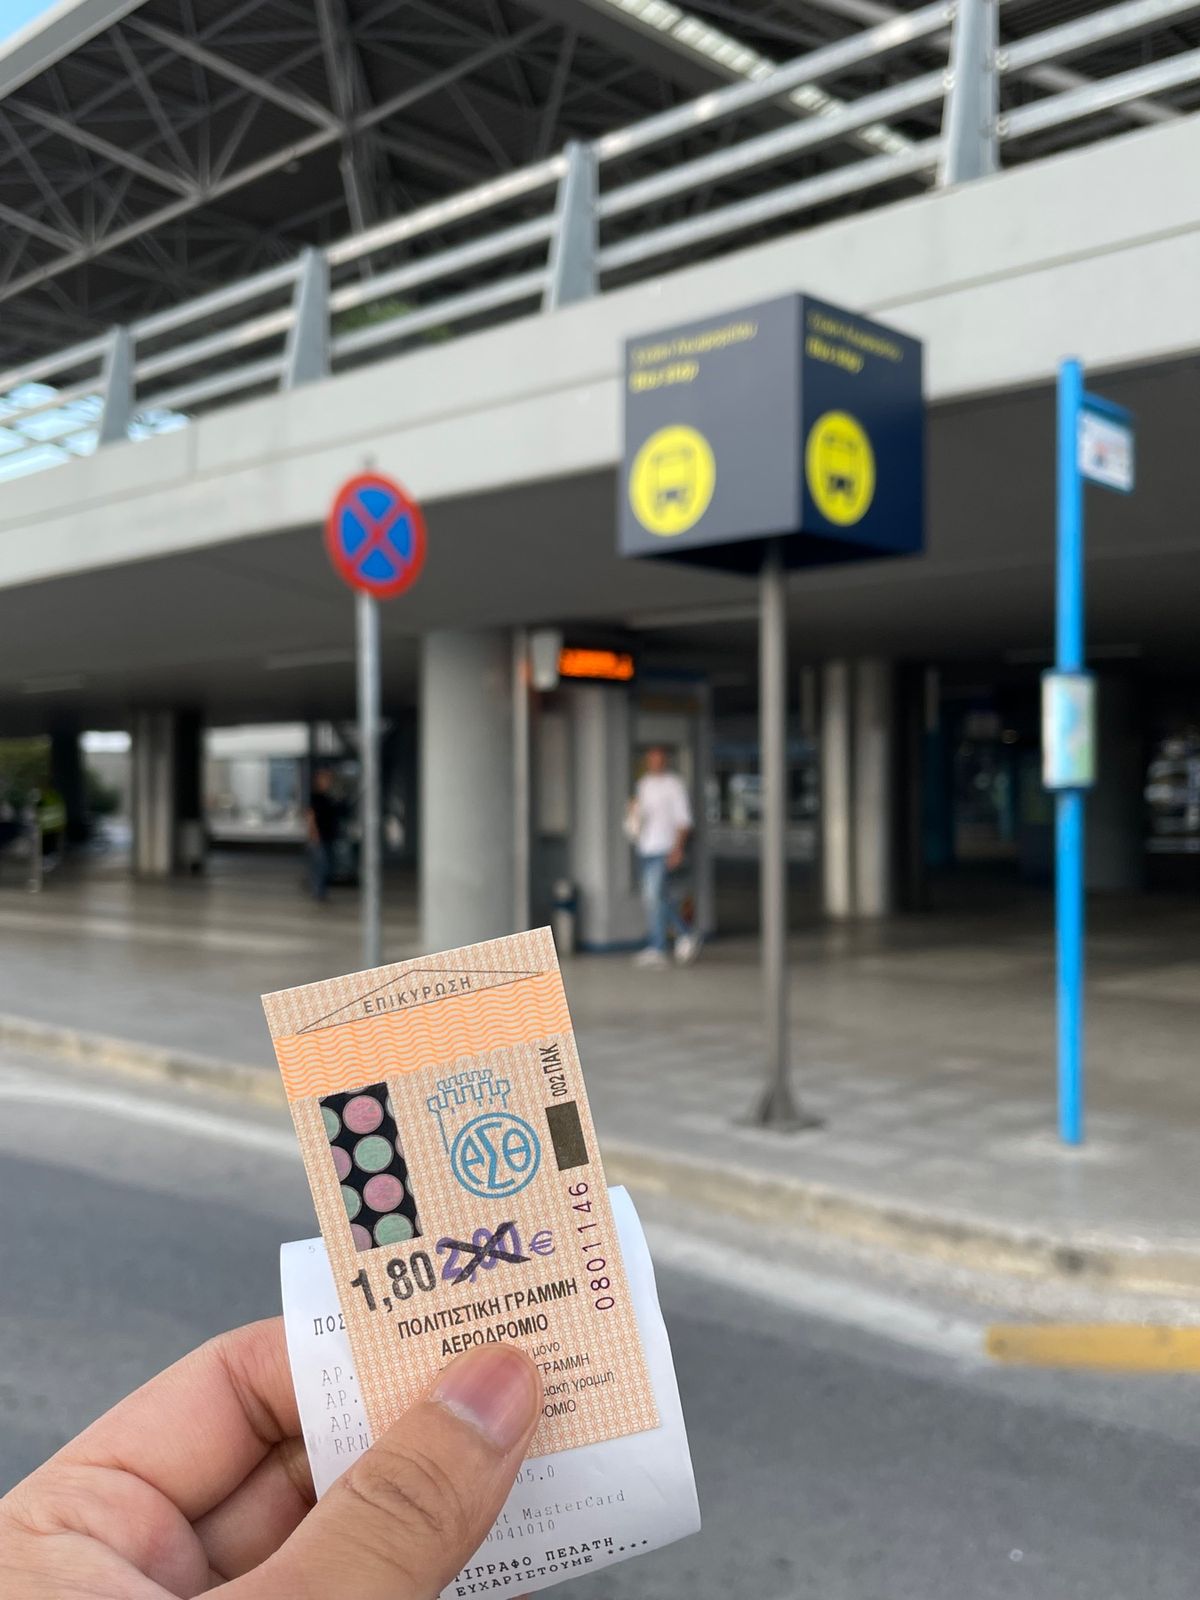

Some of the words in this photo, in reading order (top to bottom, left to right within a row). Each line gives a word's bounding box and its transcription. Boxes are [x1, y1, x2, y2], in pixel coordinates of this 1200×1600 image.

[363, 976, 471, 1013] ΕΠΙΚΥΡΩΣΗ
[568, 1182, 615, 1310] 0801146
[351, 1250, 437, 1313] 1,80
[529, 1230, 555, 1256] €
[398, 1297, 501, 1339] ΠΟΛΙΤΙΣΤΙΚΗ
[505, 1278, 579, 1312] ΓΡΑΜΜΗ
[441, 1314, 549, 1356] ΑΕΡΟΔΡΟΜΙΟ
[532, 1342, 560, 1359] μόνο
[544, 1380, 570, 1396] ιακή
[572, 1370, 615, 1393] γραμμή
[542, 1400, 576, 1418] ΟΜΙΟ
[334, 1433, 369, 1454] RRN
[522, 1489, 625, 1520] MasterCard
[546, 1537, 614, 1562] ΠΕΛΑΤΗ
[456, 1555, 593, 1597] ΕΥΧΑΡΙΣΤΟΥΜΕ
